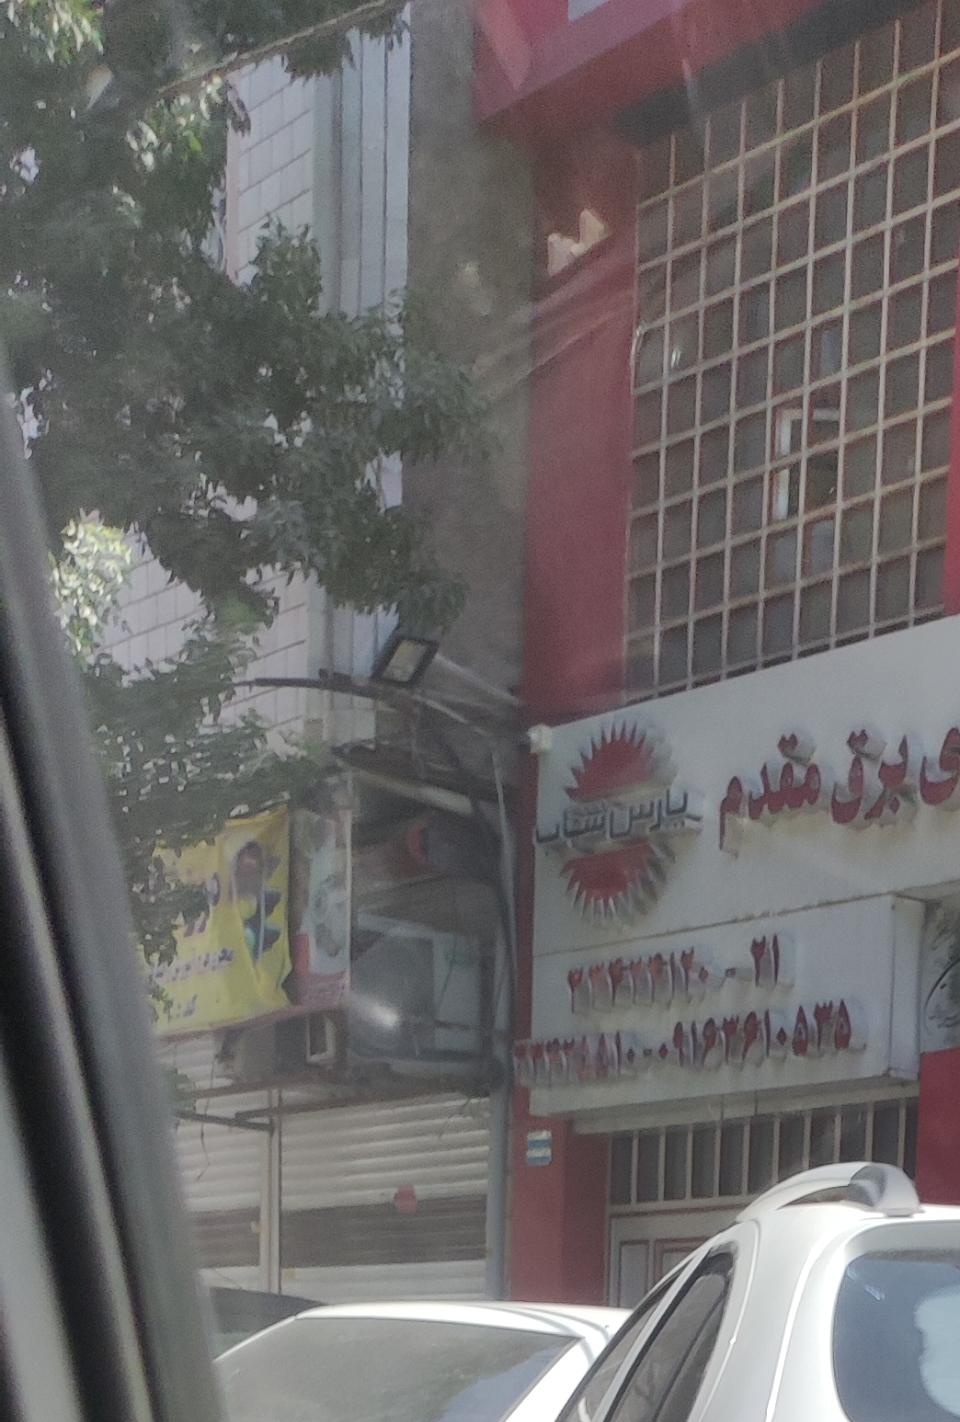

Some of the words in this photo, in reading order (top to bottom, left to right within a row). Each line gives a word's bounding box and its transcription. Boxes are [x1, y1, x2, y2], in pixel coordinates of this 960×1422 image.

[609, 787, 702, 839] پارس
[719, 732, 822, 851] مقدم
[830, 728, 908, 826] برق
